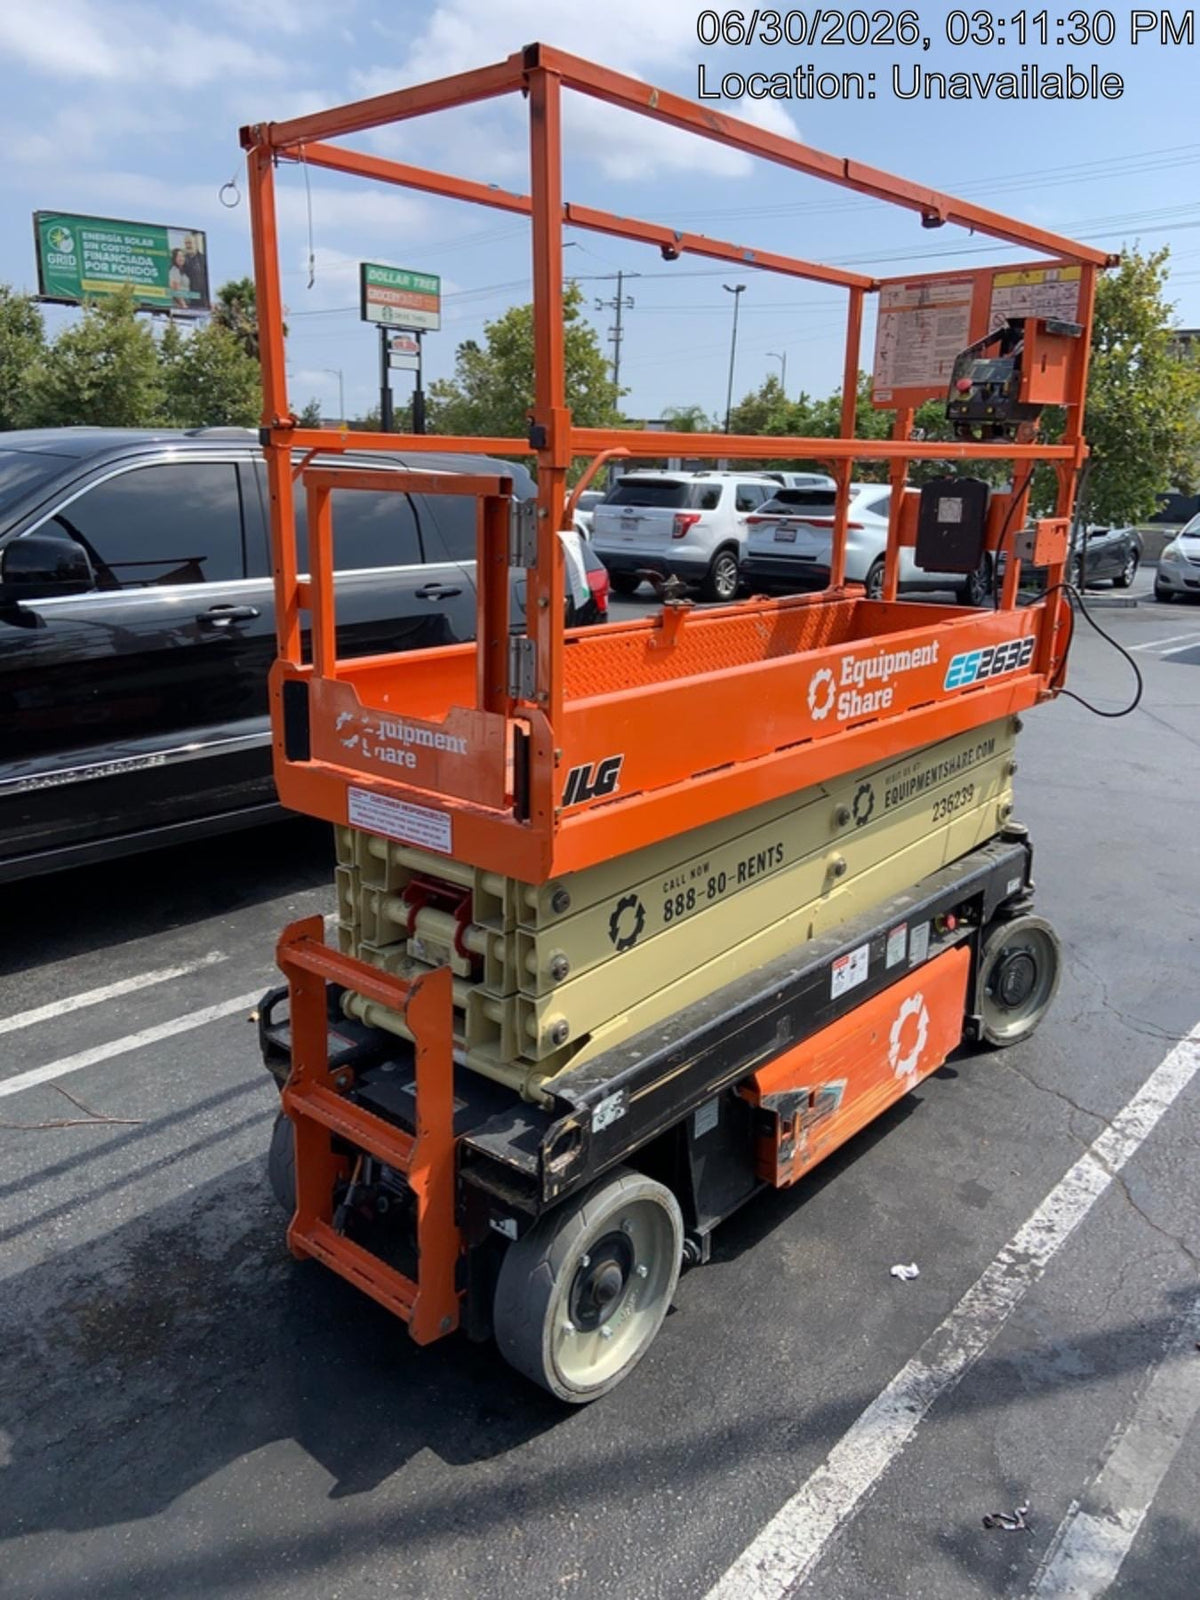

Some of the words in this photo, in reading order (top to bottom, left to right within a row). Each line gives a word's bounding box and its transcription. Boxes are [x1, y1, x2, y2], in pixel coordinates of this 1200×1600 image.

[83, 241, 99, 250] SIN
[101, 243, 132, 253] COSTO
[124, 236, 154, 247] SOLAR
[47, 252, 77, 266] GRID
[83, 250, 154, 267] FINANCIADA
[85, 260, 109, 273] POR
[111, 263, 159, 278] FONDOS
[368, 269, 410, 286] DOLLAR
[413, 276, 438, 291] TREE
[839, 639, 940, 689] Equipment
[943, 635, 1036, 692] ES2632
[837, 686, 893, 722] Share
[362, 716, 468, 756] quipment
[884, 738, 996, 809] EQUIPMENTSHARE.COM
[931, 783, 976, 822] 236239
[662, 876, 686, 893] CALL
[690, 862, 711, 880] NOW
[663, 842, 784, 923] 888-80-RENTS
